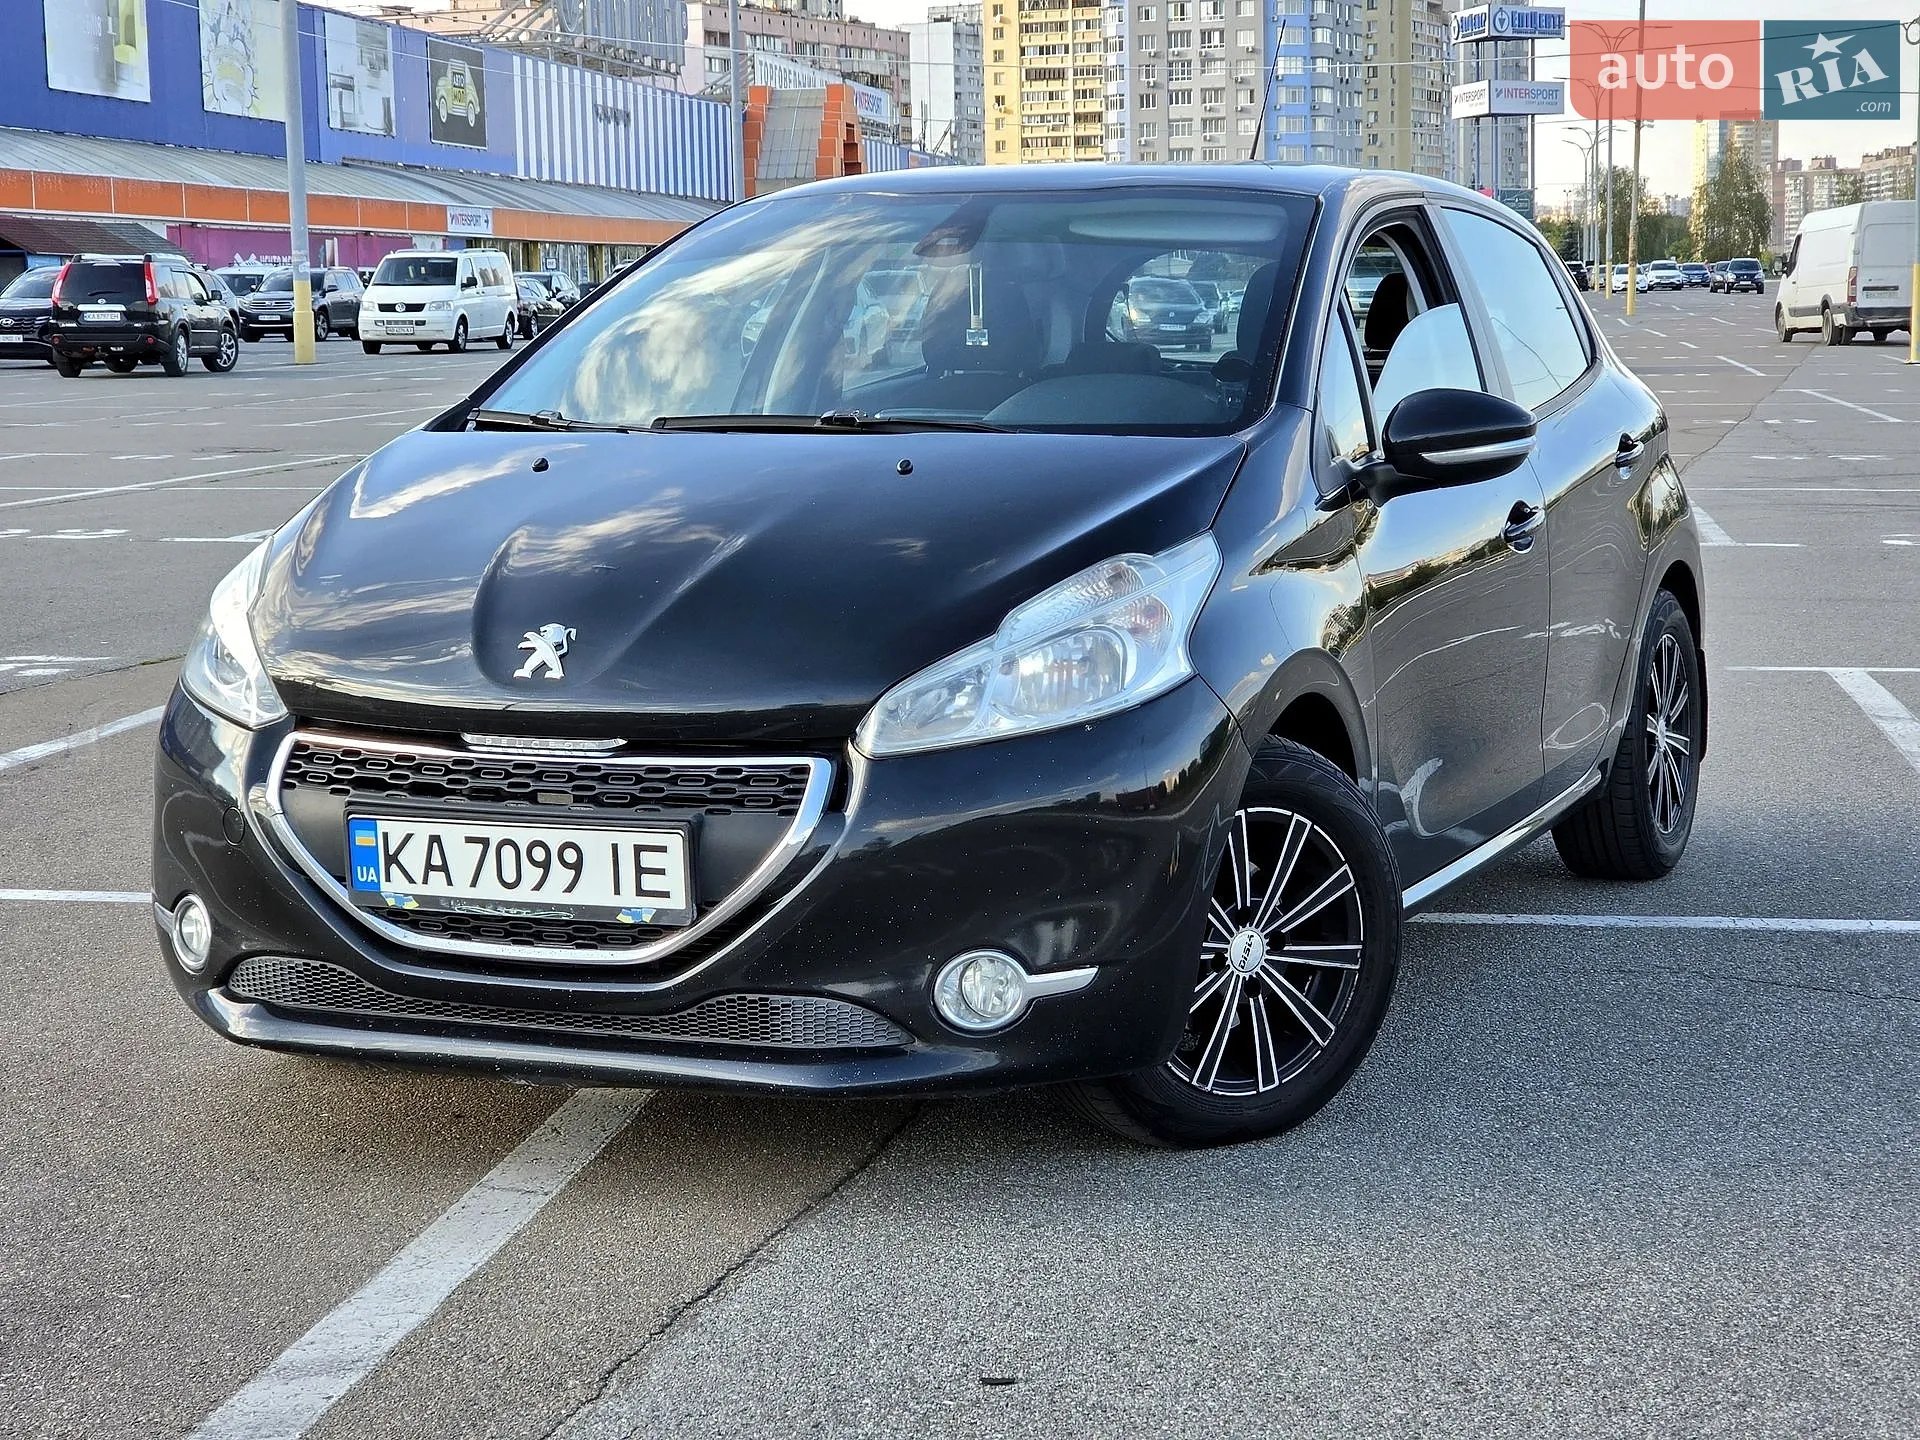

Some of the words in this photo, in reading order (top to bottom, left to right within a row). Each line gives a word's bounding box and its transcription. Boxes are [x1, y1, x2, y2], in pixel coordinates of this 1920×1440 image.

[1458, 88, 1486, 103] INTERSPORT
[1504, 87, 1560, 100] INTERSPORT
[454, 213, 481, 227] INTERSPORT
[381, 830, 454, 887] KA
[463, 835, 584, 894] 7099
[610, 842, 671, 899] IE
[356, 865, 378, 883] UA
